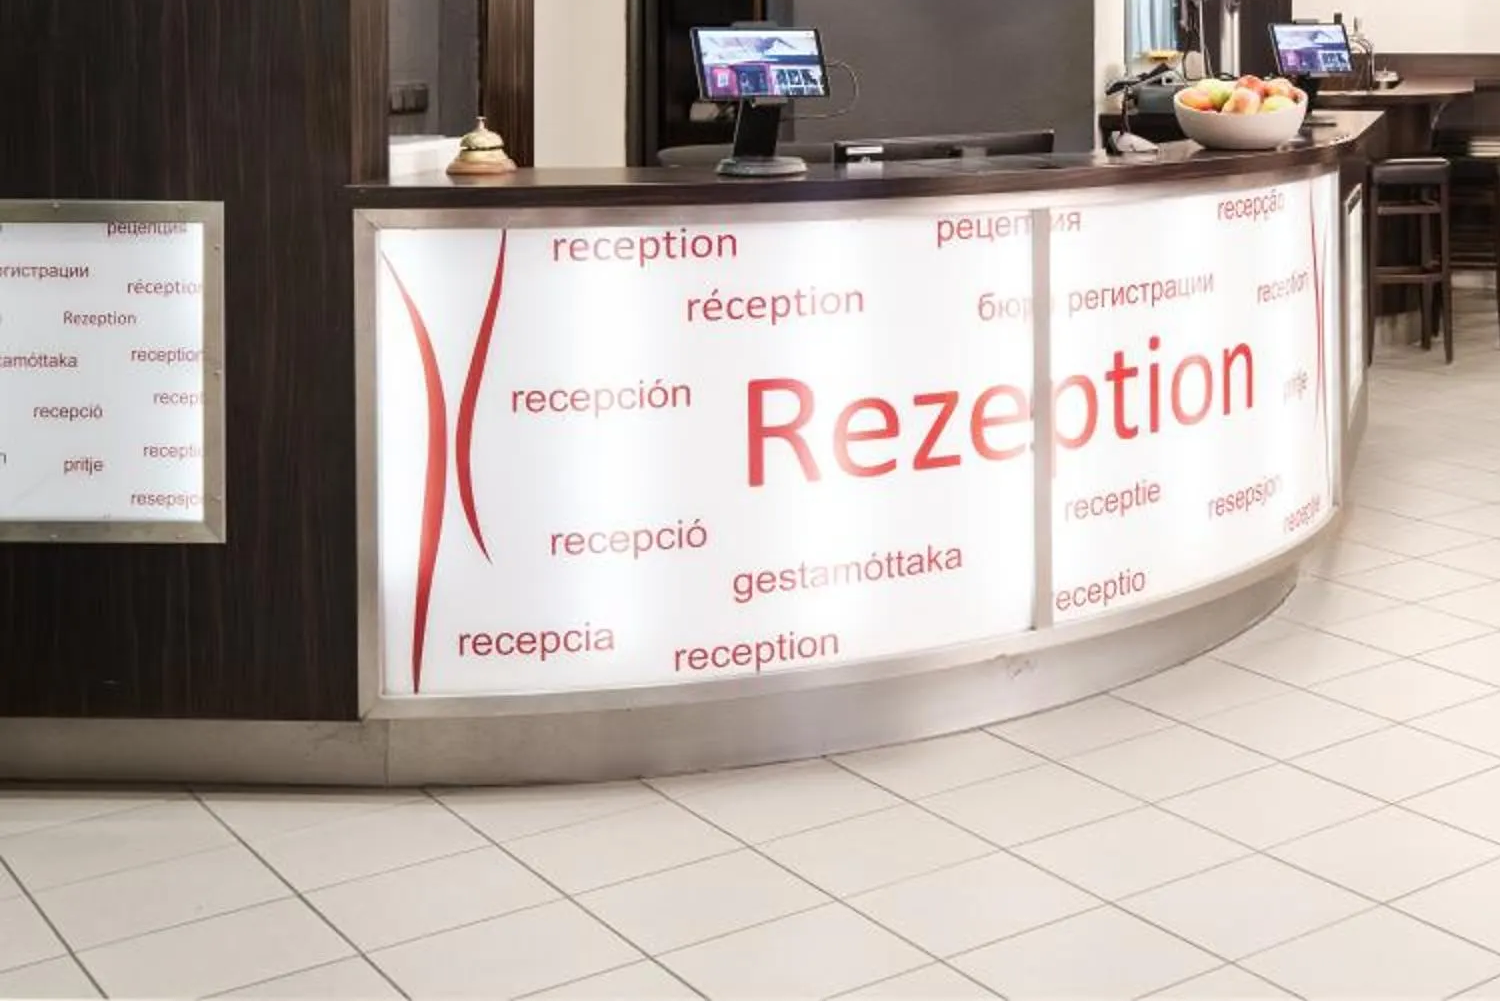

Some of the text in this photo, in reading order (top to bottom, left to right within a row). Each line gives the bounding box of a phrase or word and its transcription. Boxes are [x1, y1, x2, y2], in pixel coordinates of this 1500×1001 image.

[552, 228, 738, 267] reception
[936, 210, 1081, 247] рецепия
[687, 288, 865, 326] réception
[1068, 272, 1214, 319] регистрации
[64, 310, 137, 328] Rezeption
[33, 403, 103, 422] recepció
[511, 379, 692, 419] recepción
[747, 334, 1254, 489] Rezeption
[64, 456, 104, 477] pritje
[1065, 479, 1162, 523] receptie
[550, 518, 708, 559] recepció
[733, 544, 963, 604] gestamóttaka
[1055, 567, 1147, 612] eceptio
[457, 622, 616, 661] recepcia
[674, 630, 840, 673] reception
